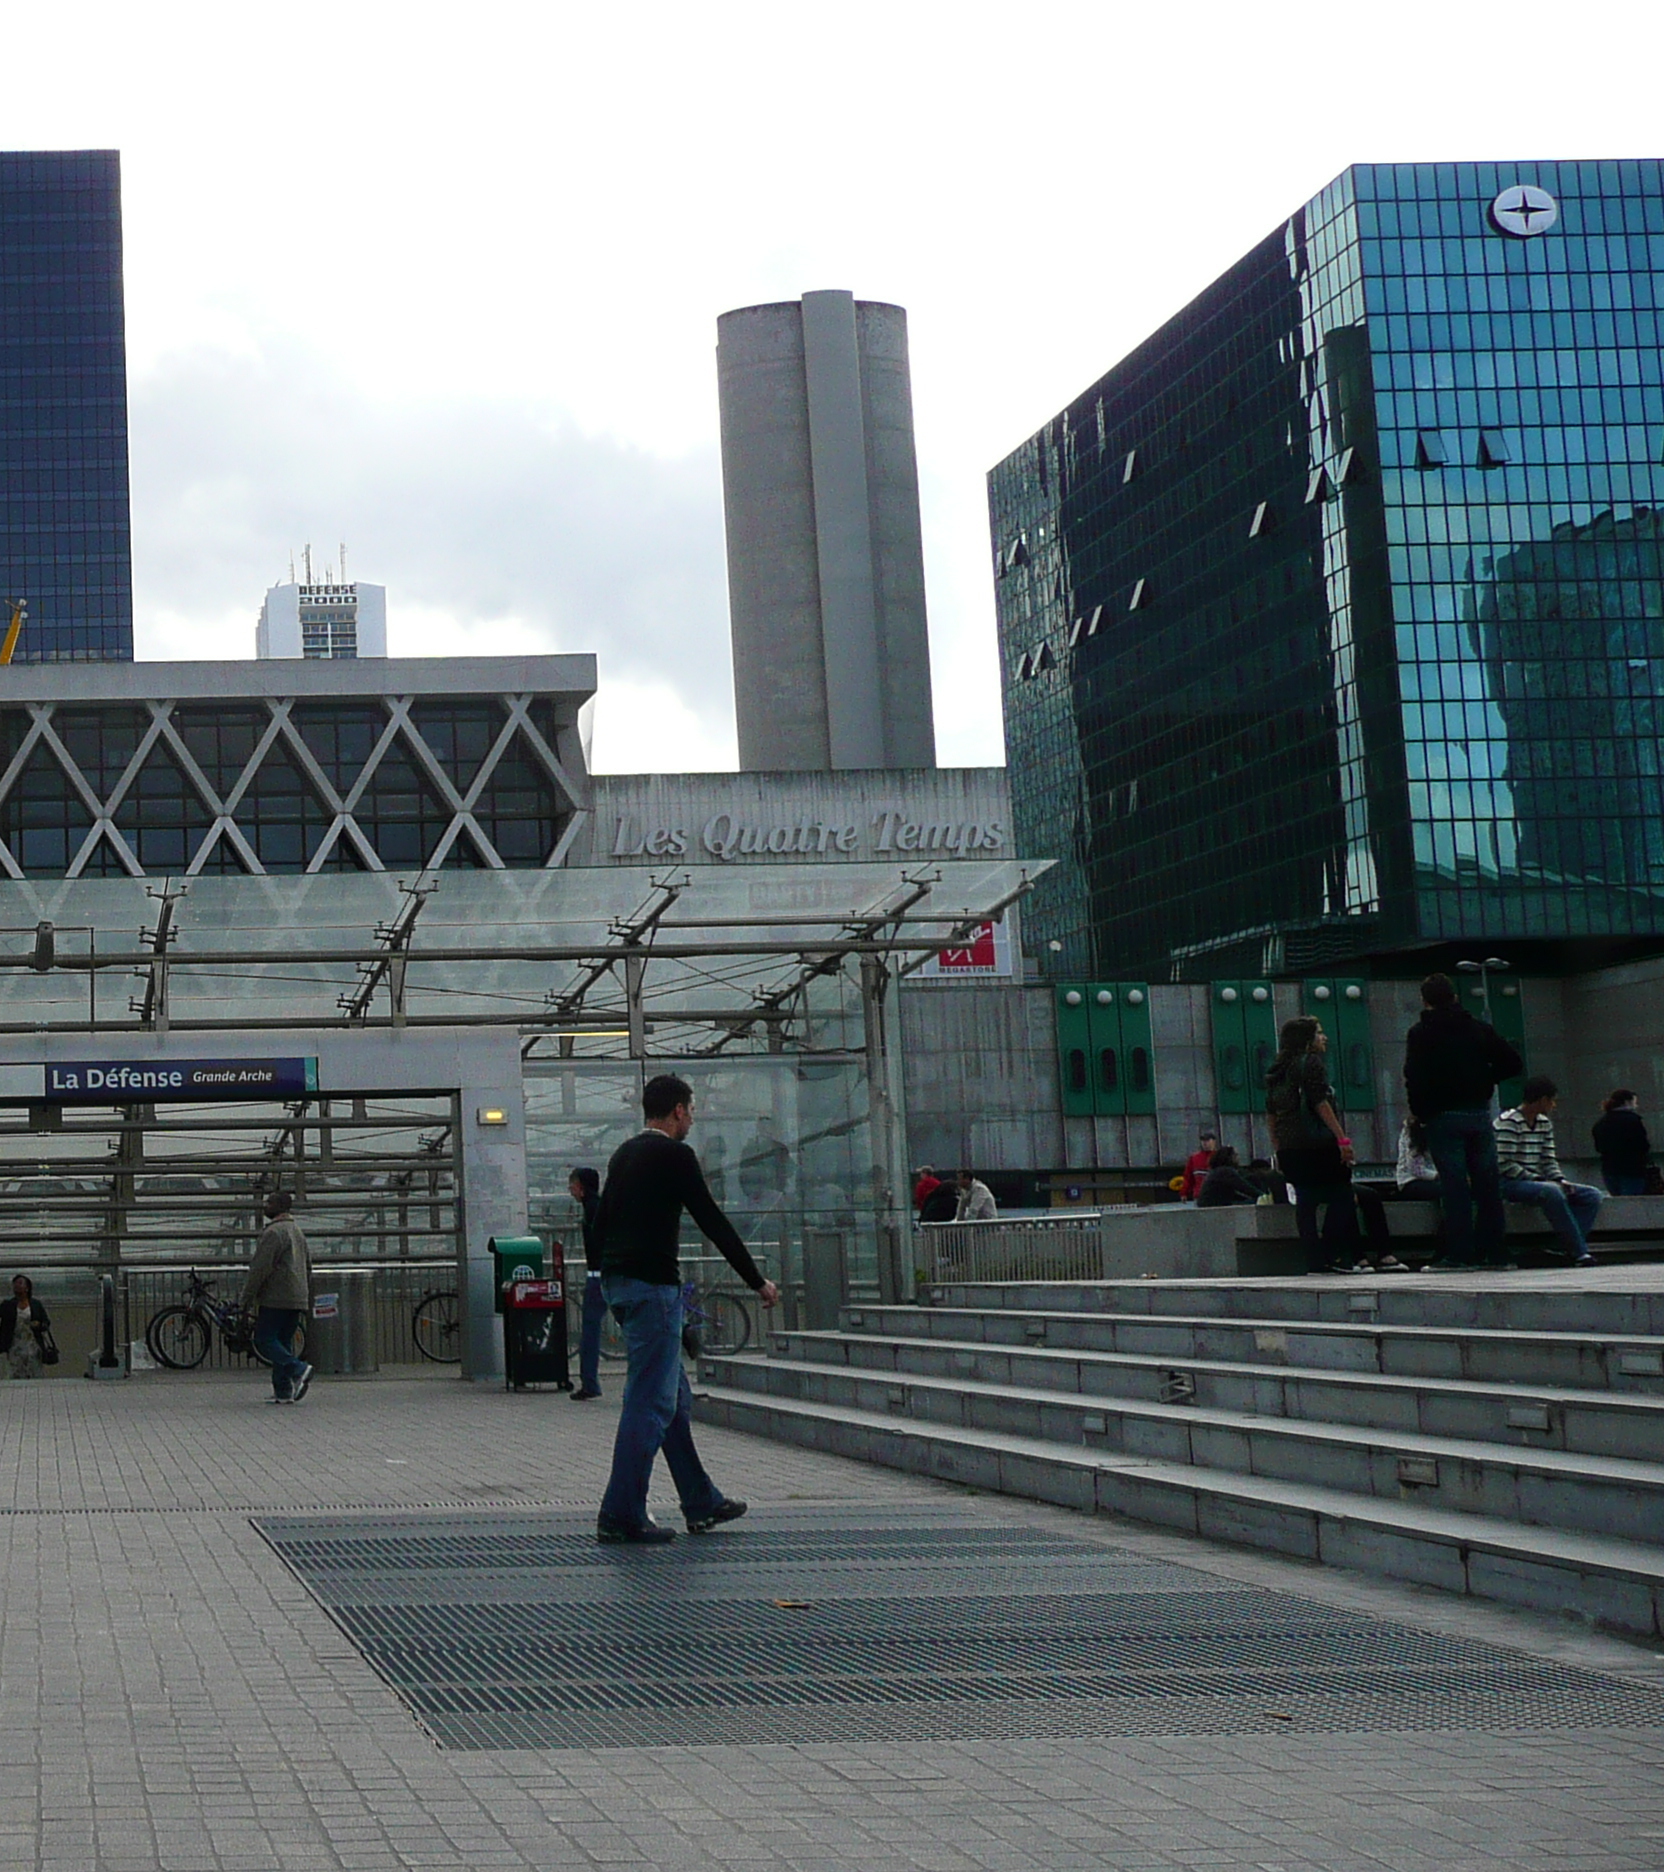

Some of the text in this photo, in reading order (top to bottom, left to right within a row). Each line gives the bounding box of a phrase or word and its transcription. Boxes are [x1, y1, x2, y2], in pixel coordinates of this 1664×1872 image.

[299, 584, 357, 595] DEFENSE
[299, 596, 357, 604] 2000
[611, 811, 1006, 861] Les Quatre Temps
[52, 1067, 272, 1089] La Défense Grande Arche
